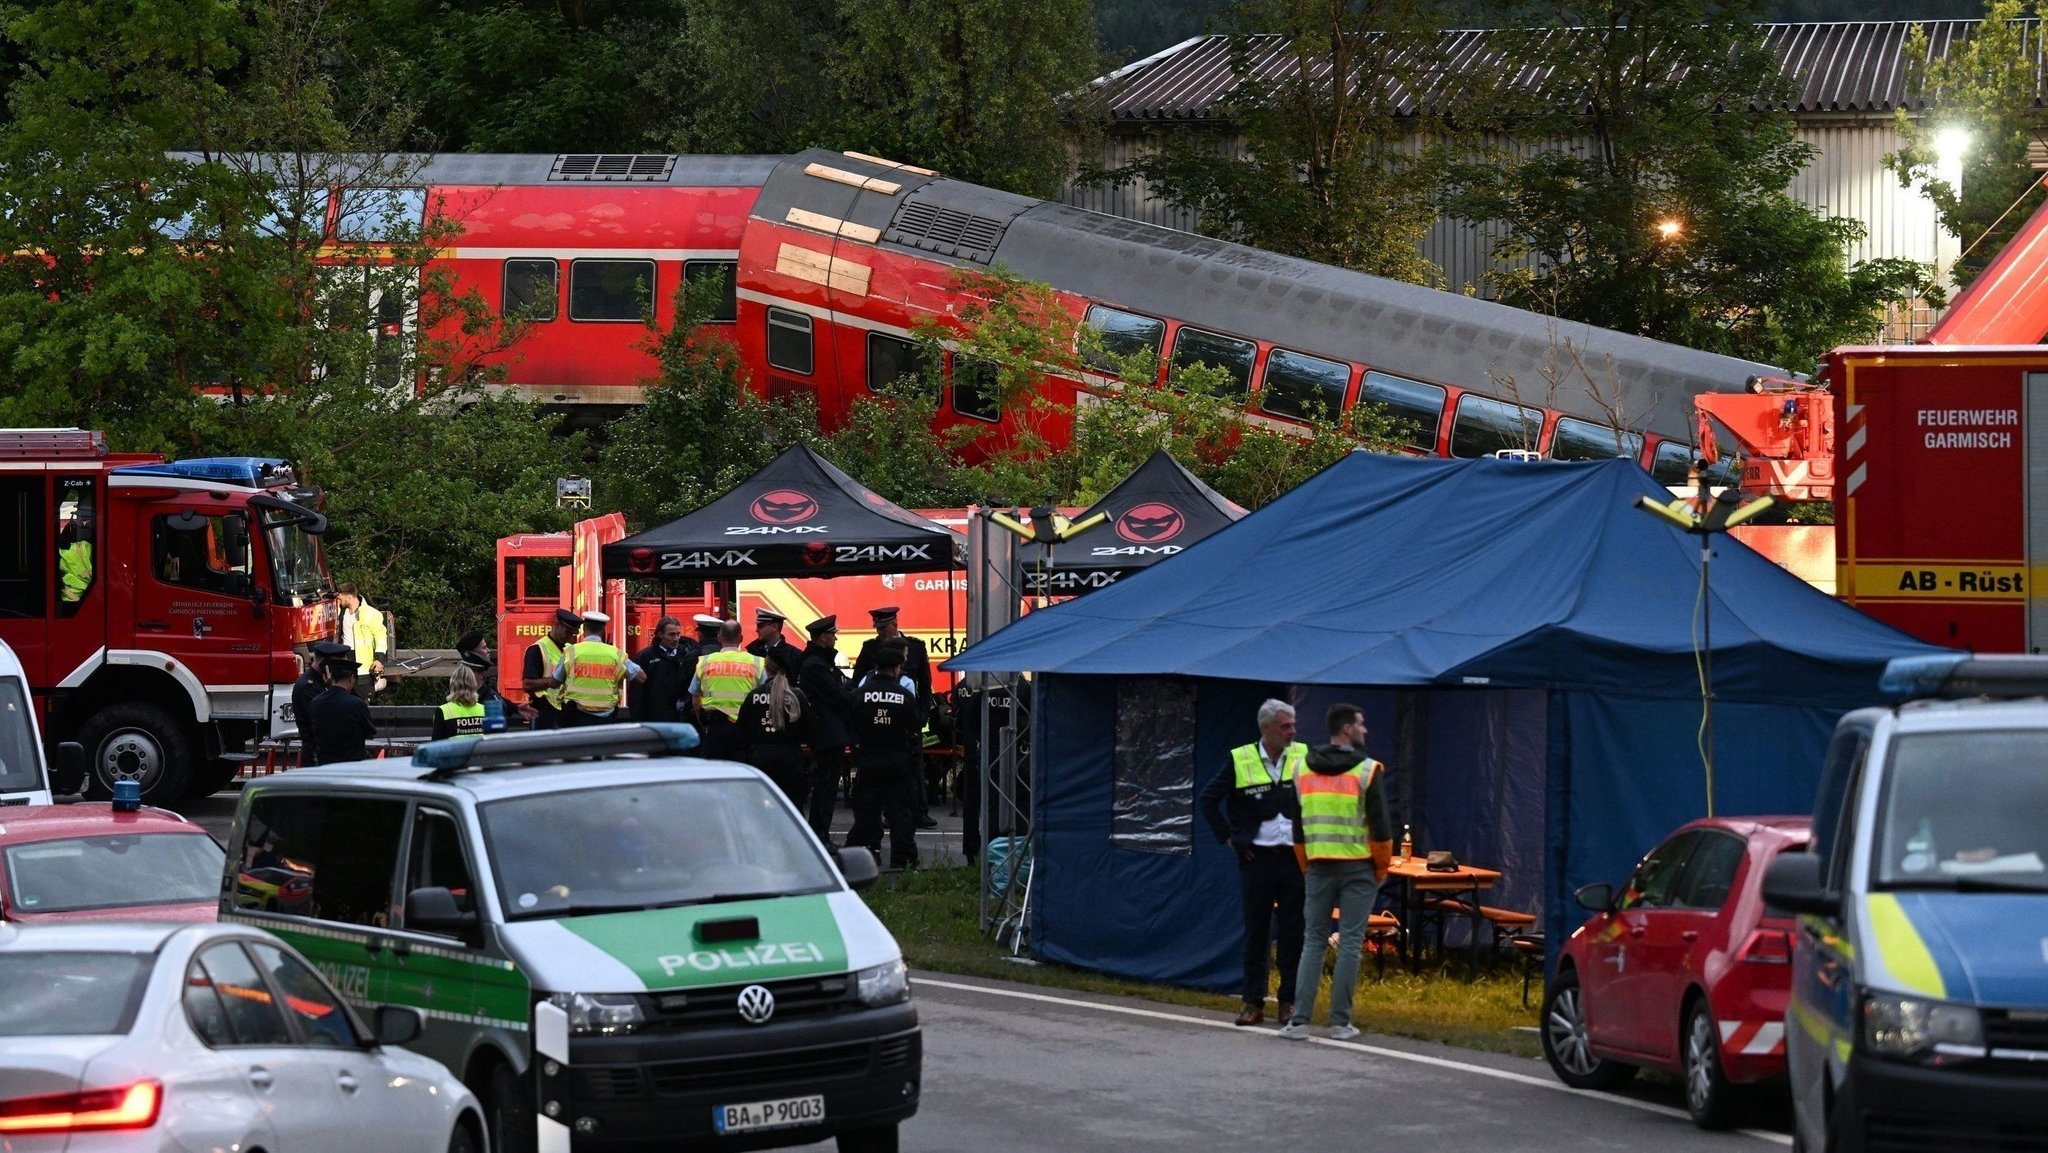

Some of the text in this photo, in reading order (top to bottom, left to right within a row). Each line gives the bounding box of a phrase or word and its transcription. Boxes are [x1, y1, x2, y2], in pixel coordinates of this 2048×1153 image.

[1917, 409, 2018, 427] FEUERWEHR
[1924, 432, 2011, 449] GARMISCH
[724, 525, 829, 536] 24MX
[660, 549, 759, 570] 24MX
[835, 544, 933, 562] 24MX
[914, 579, 968, 591] GARMIS
[1025, 571, 1122, 588] 24MX
[1898, 571, 1937, 591] AB
[1959, 570, 2024, 593] Rüst
[515, 625, 553, 636] FEUER
[930, 637, 968, 654] KRA
[864, 691, 905, 704] POLIZEI
[873, 717, 891, 725] 5411
[877, 708, 888, 717] BY
[658, 941, 825, 977] POLIZEI
[727, 1099, 822, 1127] BA P 9003
